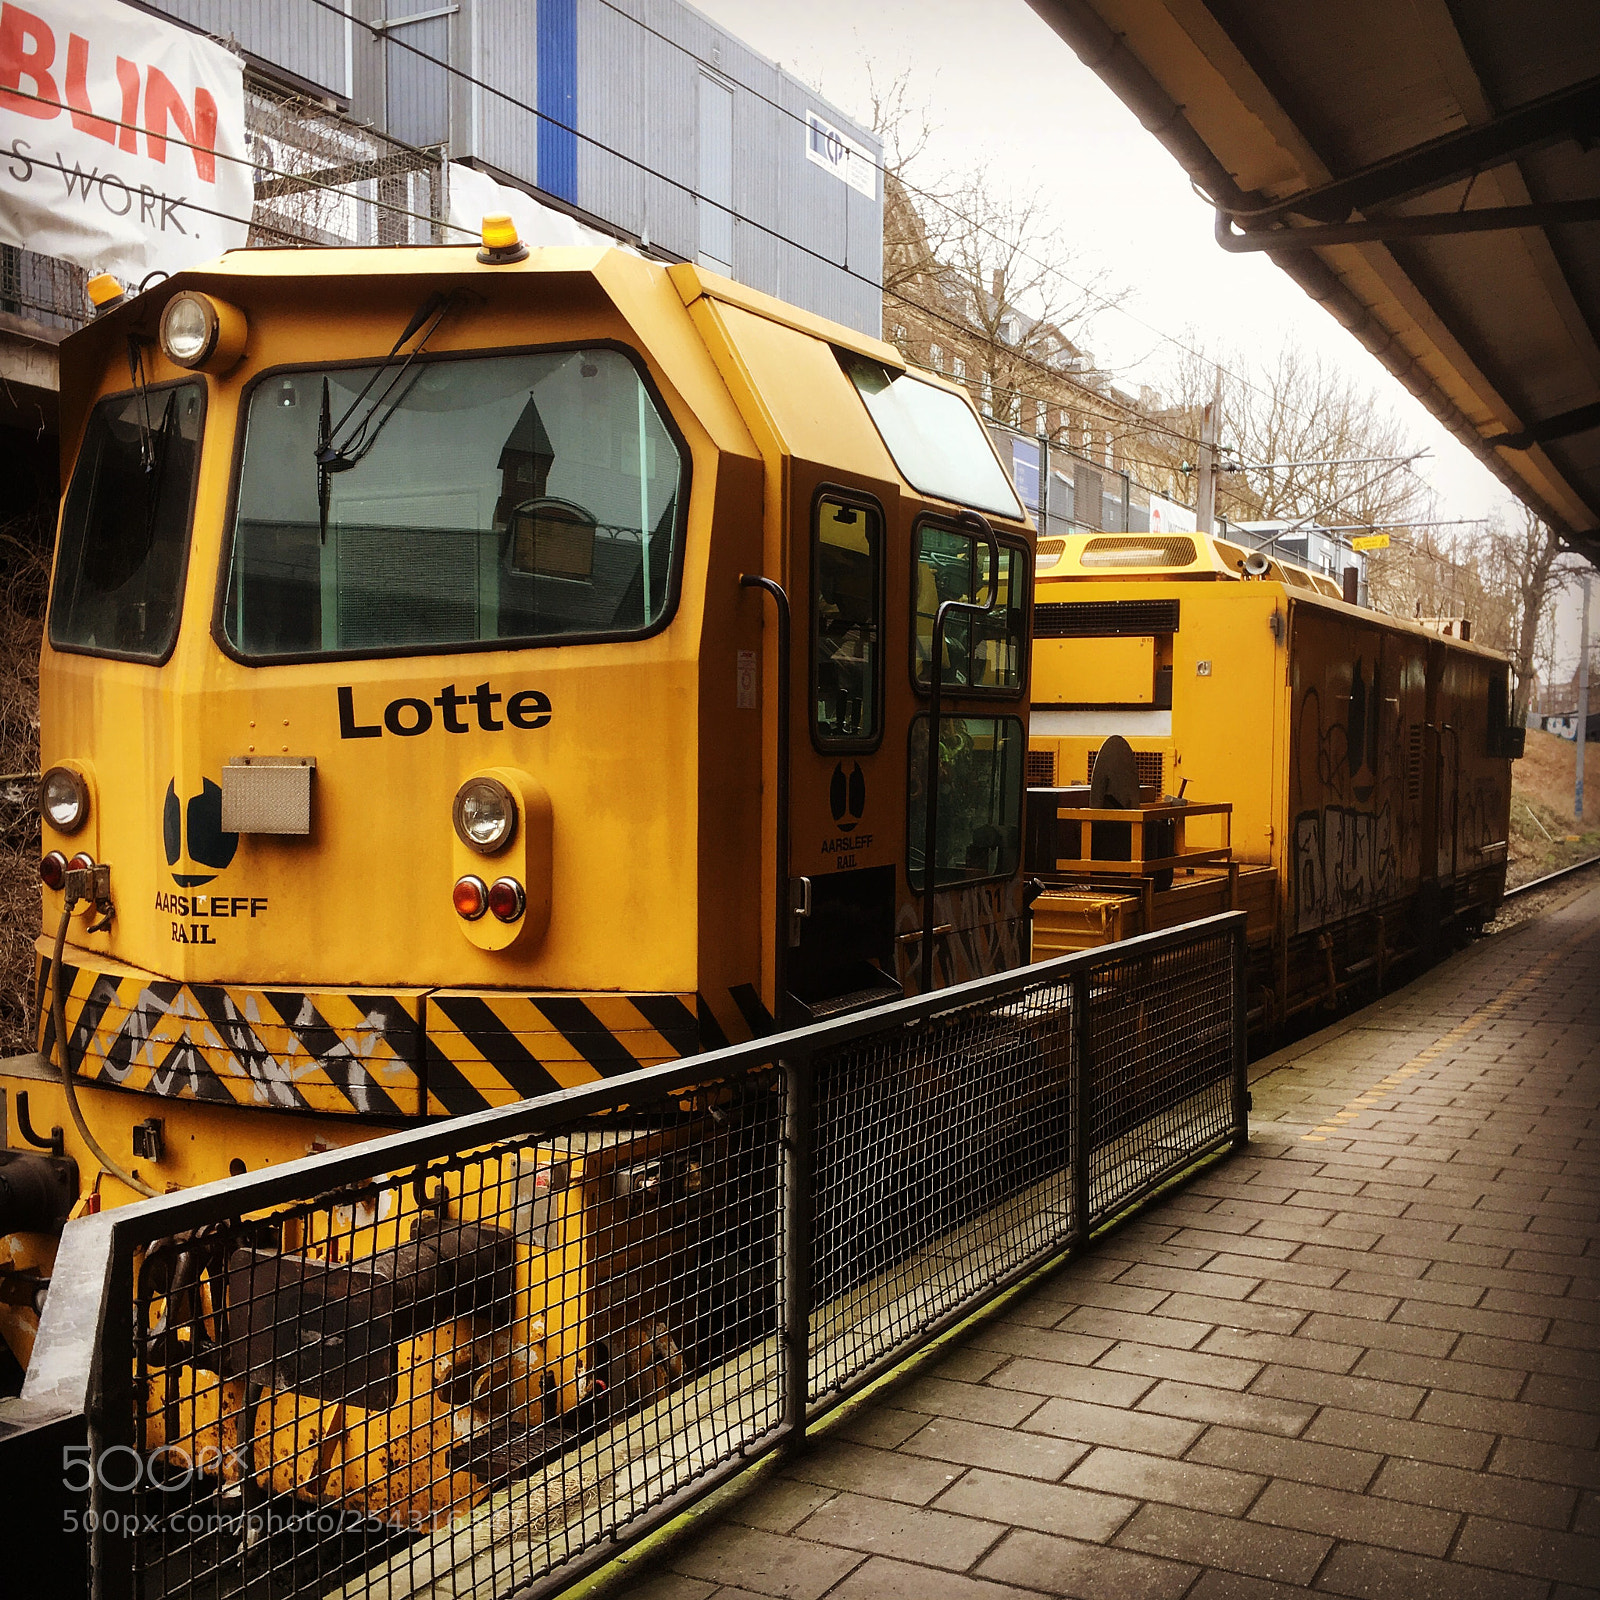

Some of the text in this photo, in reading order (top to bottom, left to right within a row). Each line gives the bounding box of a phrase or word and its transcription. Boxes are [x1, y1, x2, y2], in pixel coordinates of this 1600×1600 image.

[0, 2, 218, 184] BLIN
[8, 138, 33, 183] S
[56, 152, 200, 240] WORK.
[337, 682, 553, 739] Lotte
[821, 835, 873, 854] AARSLEFF
[837, 854, 857, 869] RAIL
[155, 891, 268, 917] AARSLEFF
[171, 922, 216, 944] RAIL
